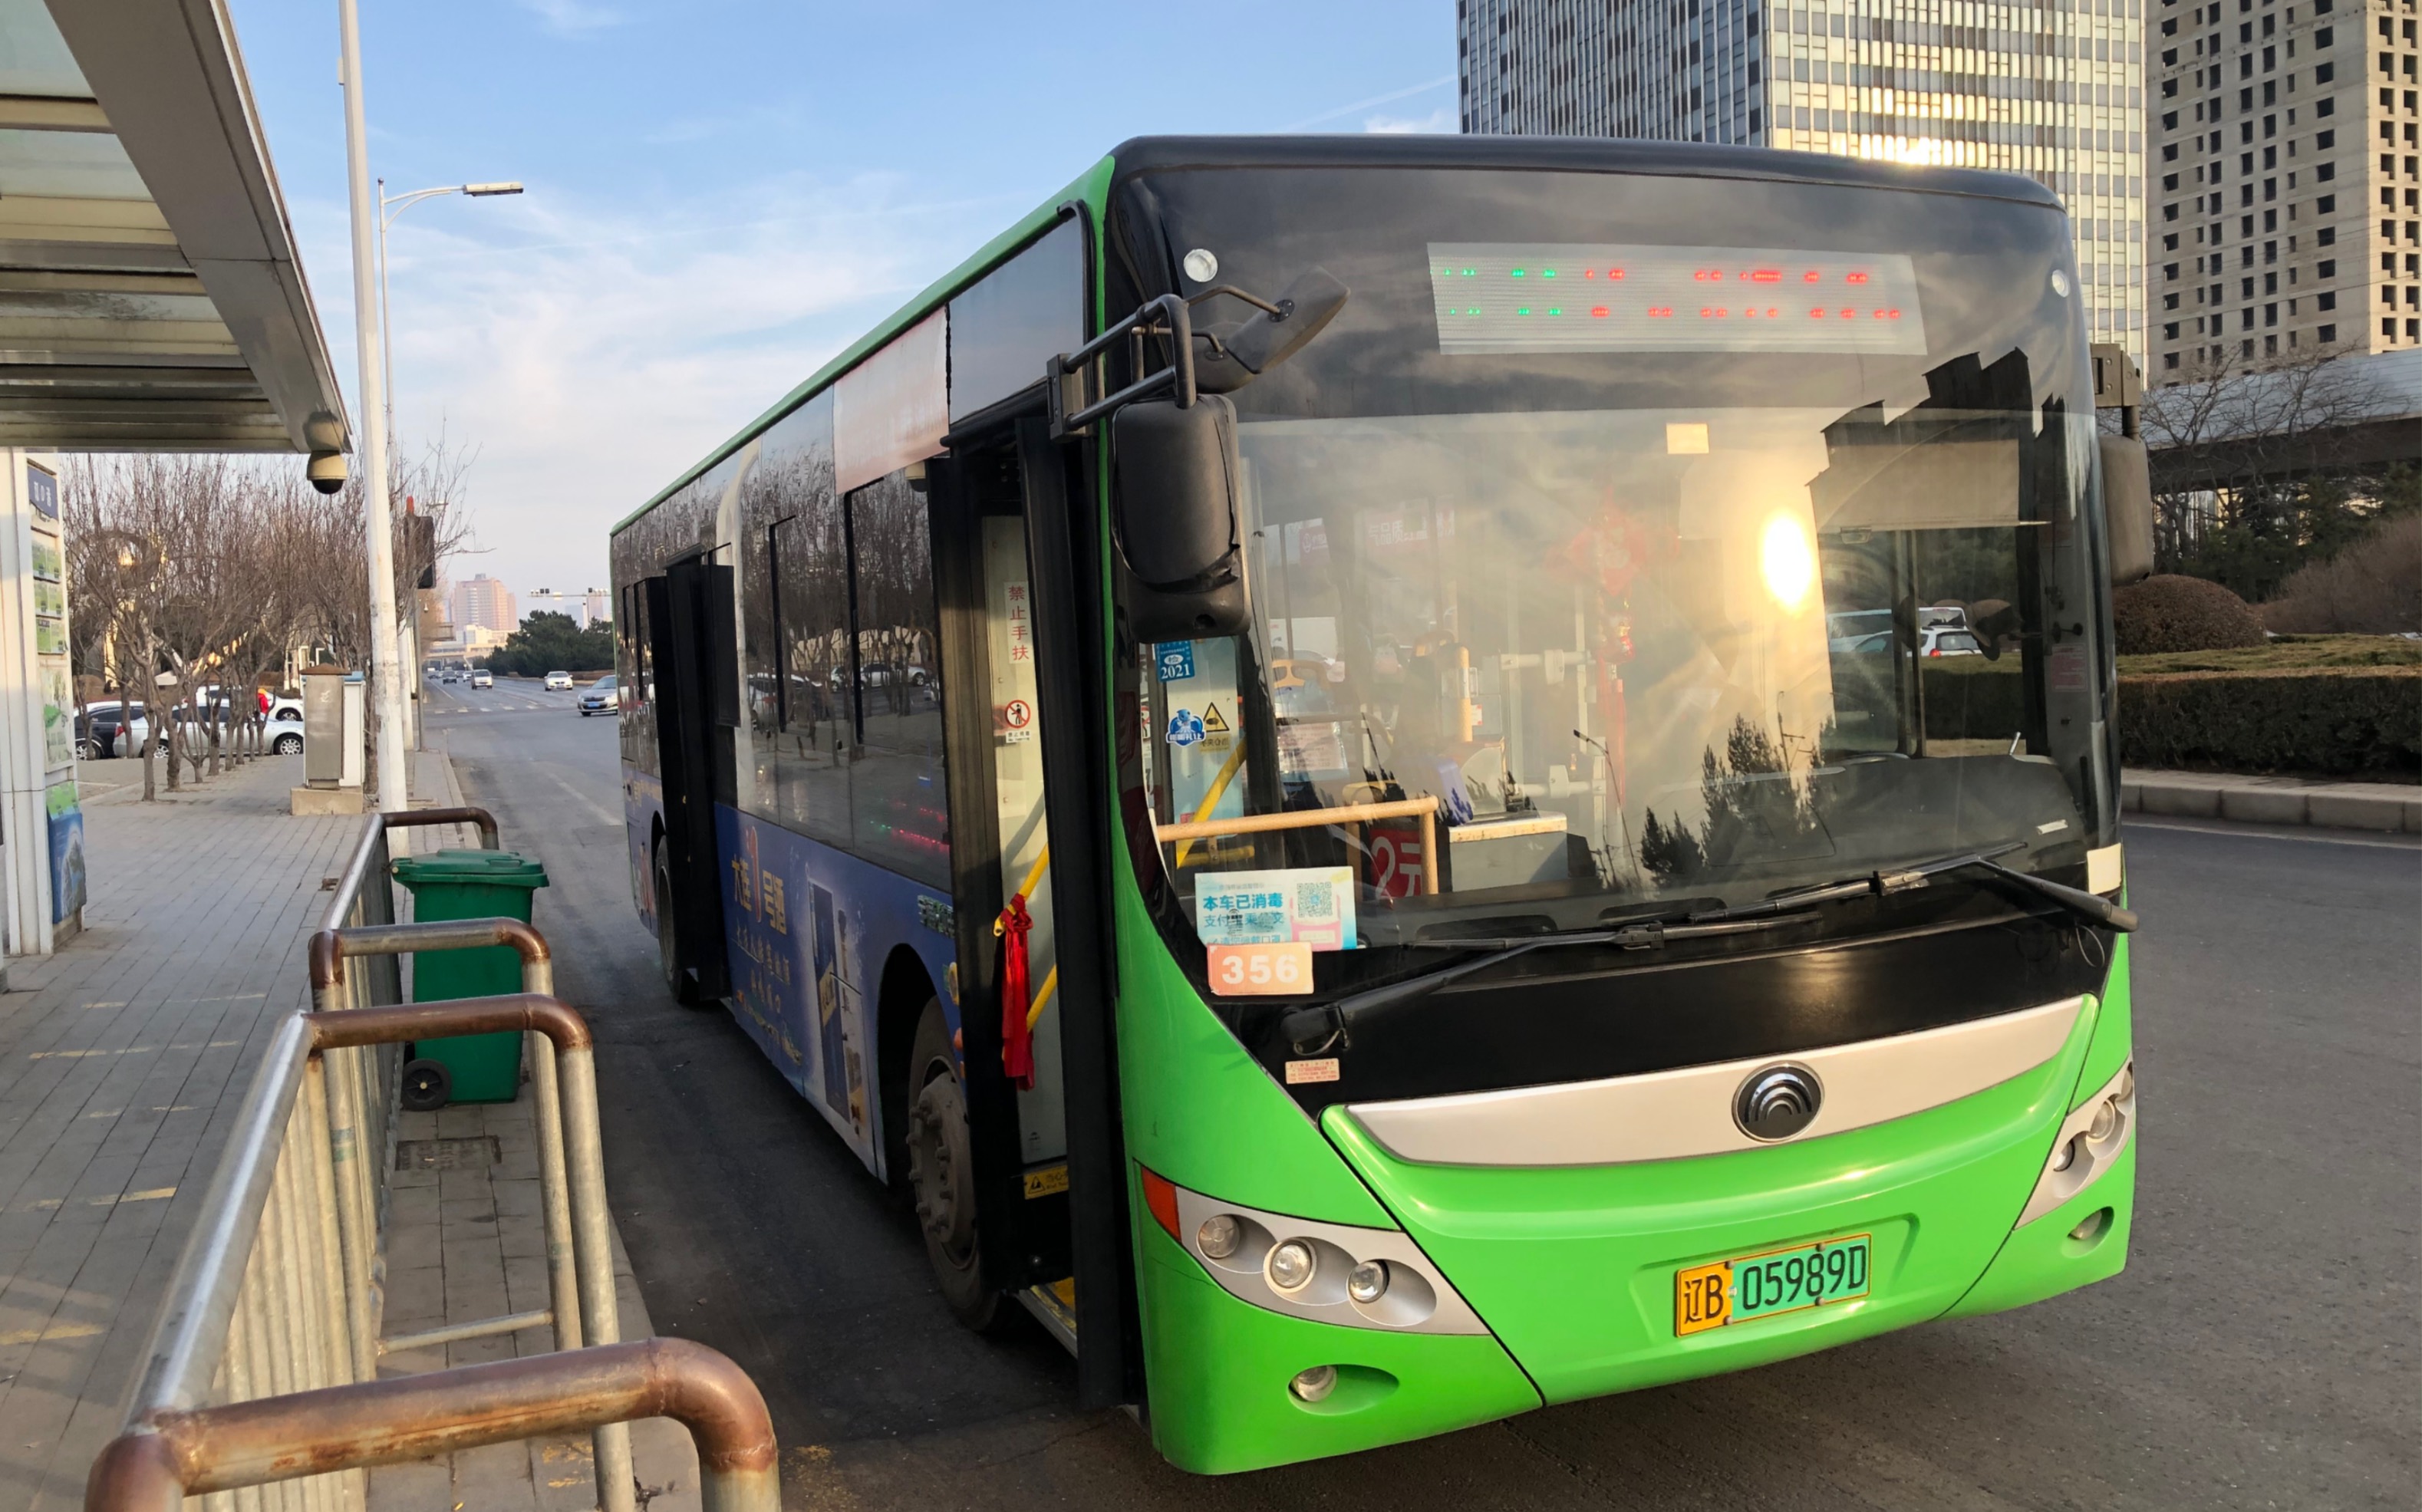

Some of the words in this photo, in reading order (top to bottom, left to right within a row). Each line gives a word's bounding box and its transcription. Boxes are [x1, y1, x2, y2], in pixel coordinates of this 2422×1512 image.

[1008, 585, 1030, 660] 禁止手扶
[1161, 664, 1191, 680] 2021
[1203, 892, 1283, 911] 本车已消毒
[1221, 954, 1299, 984] 356
